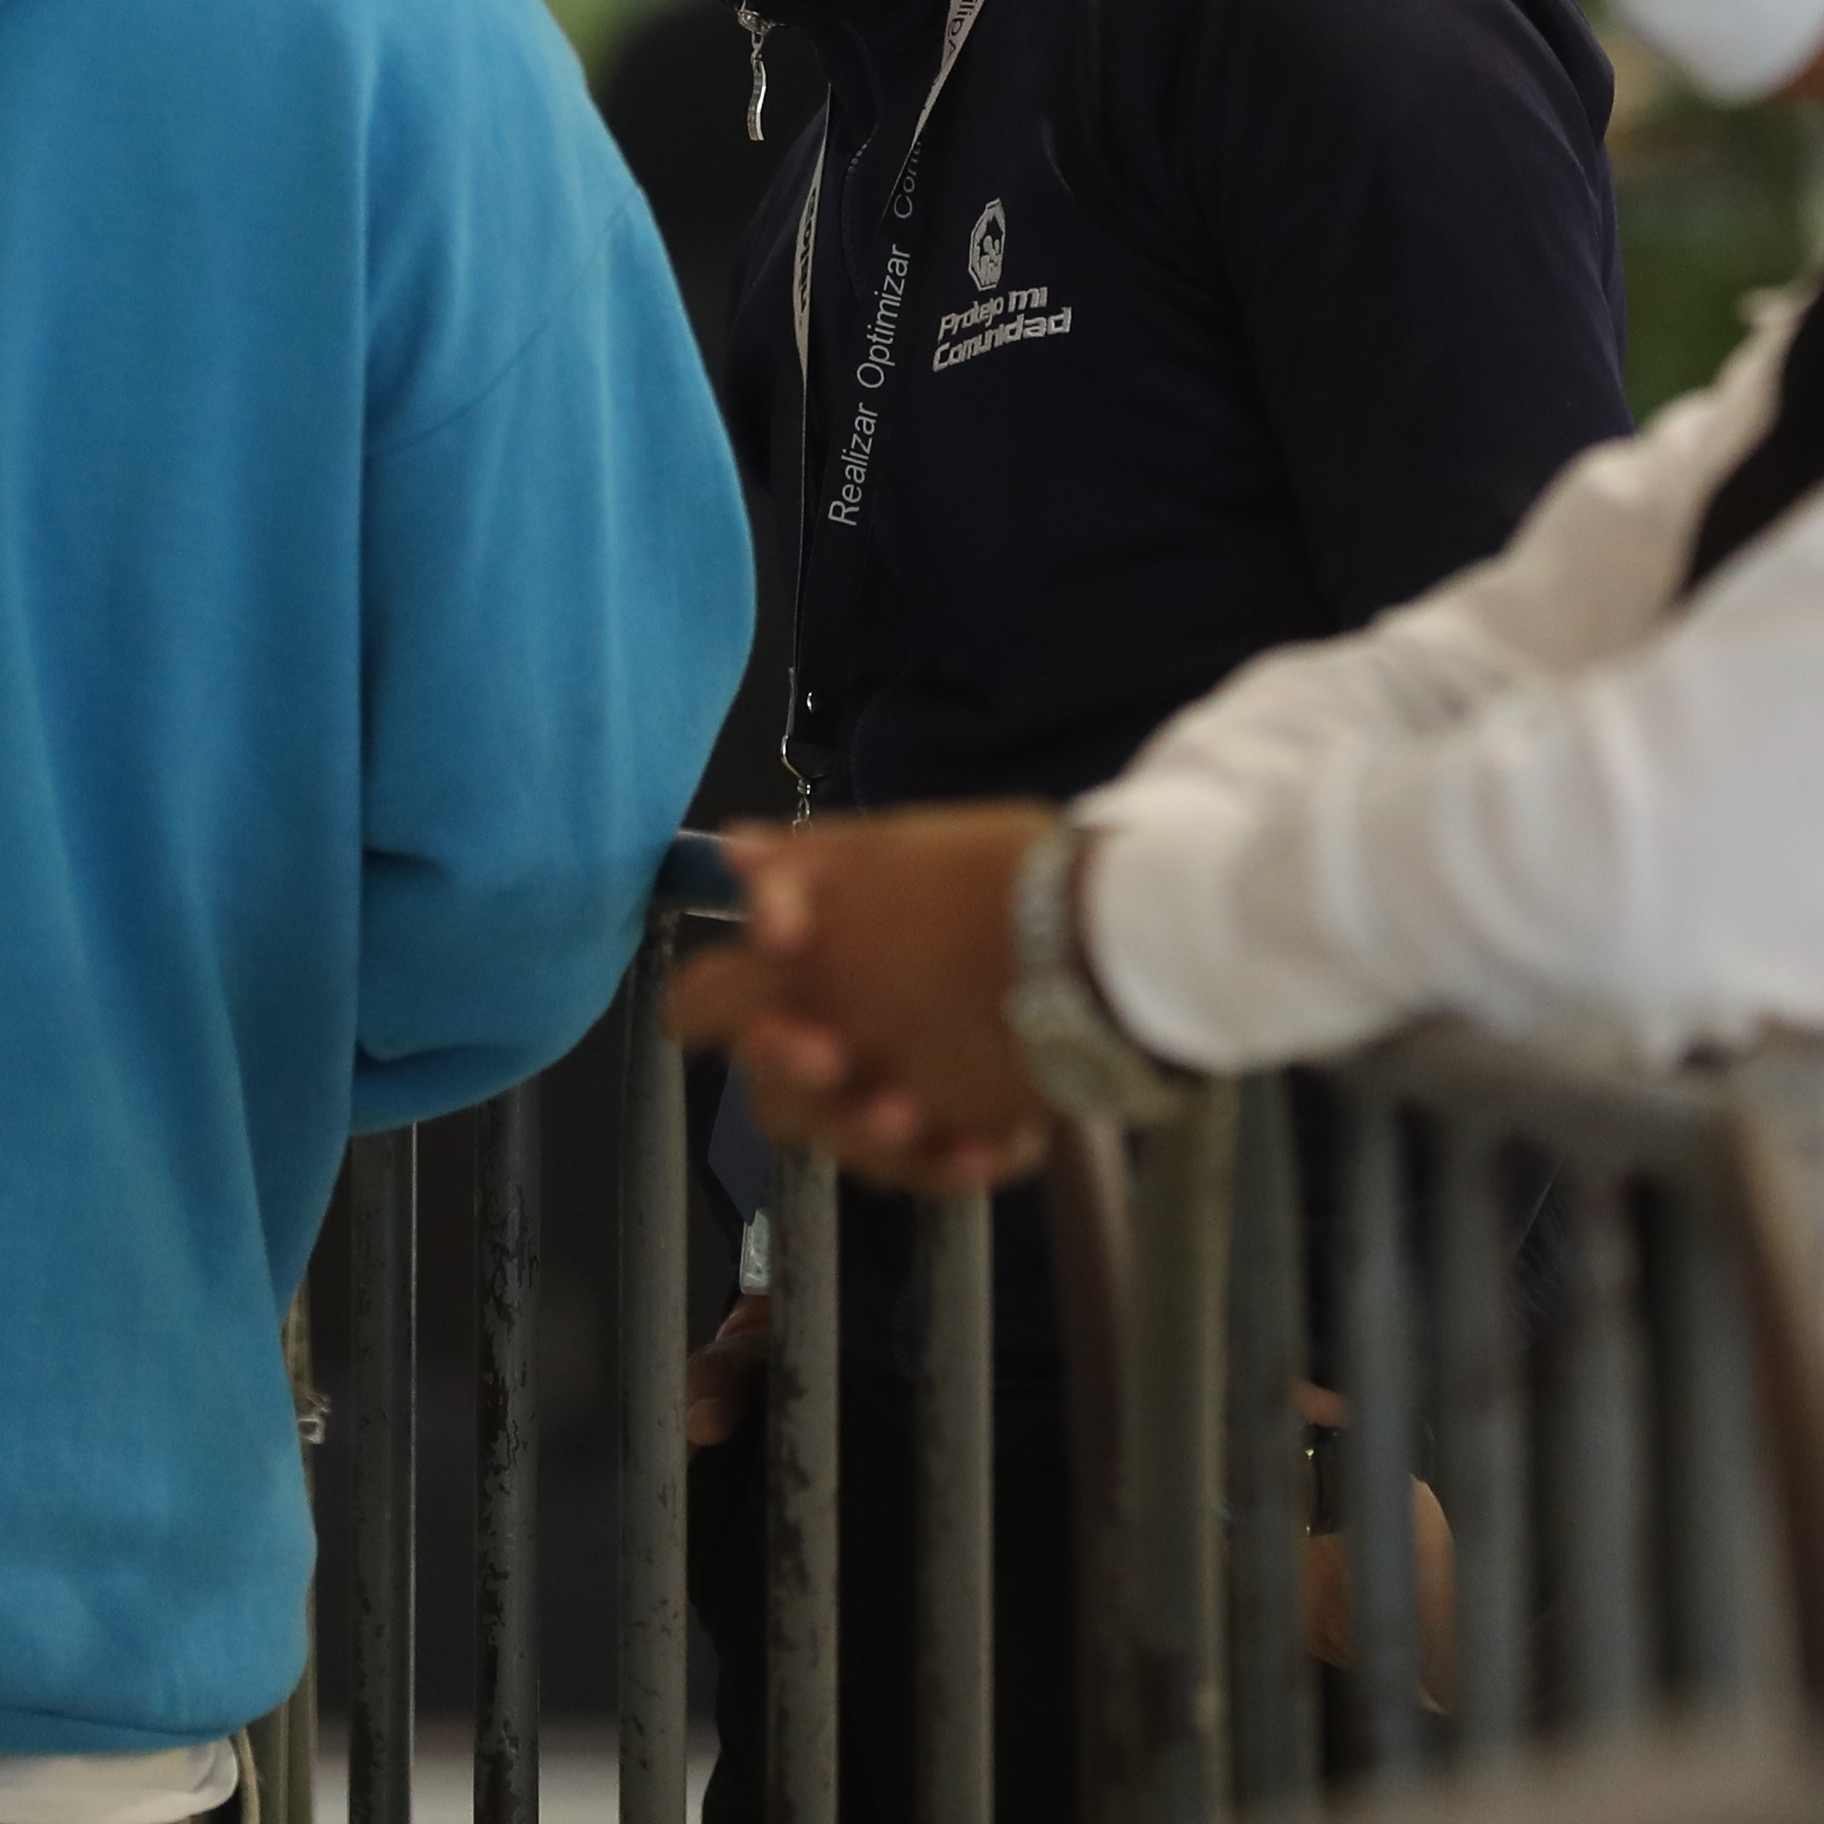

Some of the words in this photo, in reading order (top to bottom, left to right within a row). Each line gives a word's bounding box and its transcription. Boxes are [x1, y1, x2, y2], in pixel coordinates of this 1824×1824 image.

[932, 306, 1073, 373] Comunidad
[937, 296, 1004, 344] Protejo
[828, 402, 879, 527] Realizar
[857, 243, 911, 390] Optimizar
